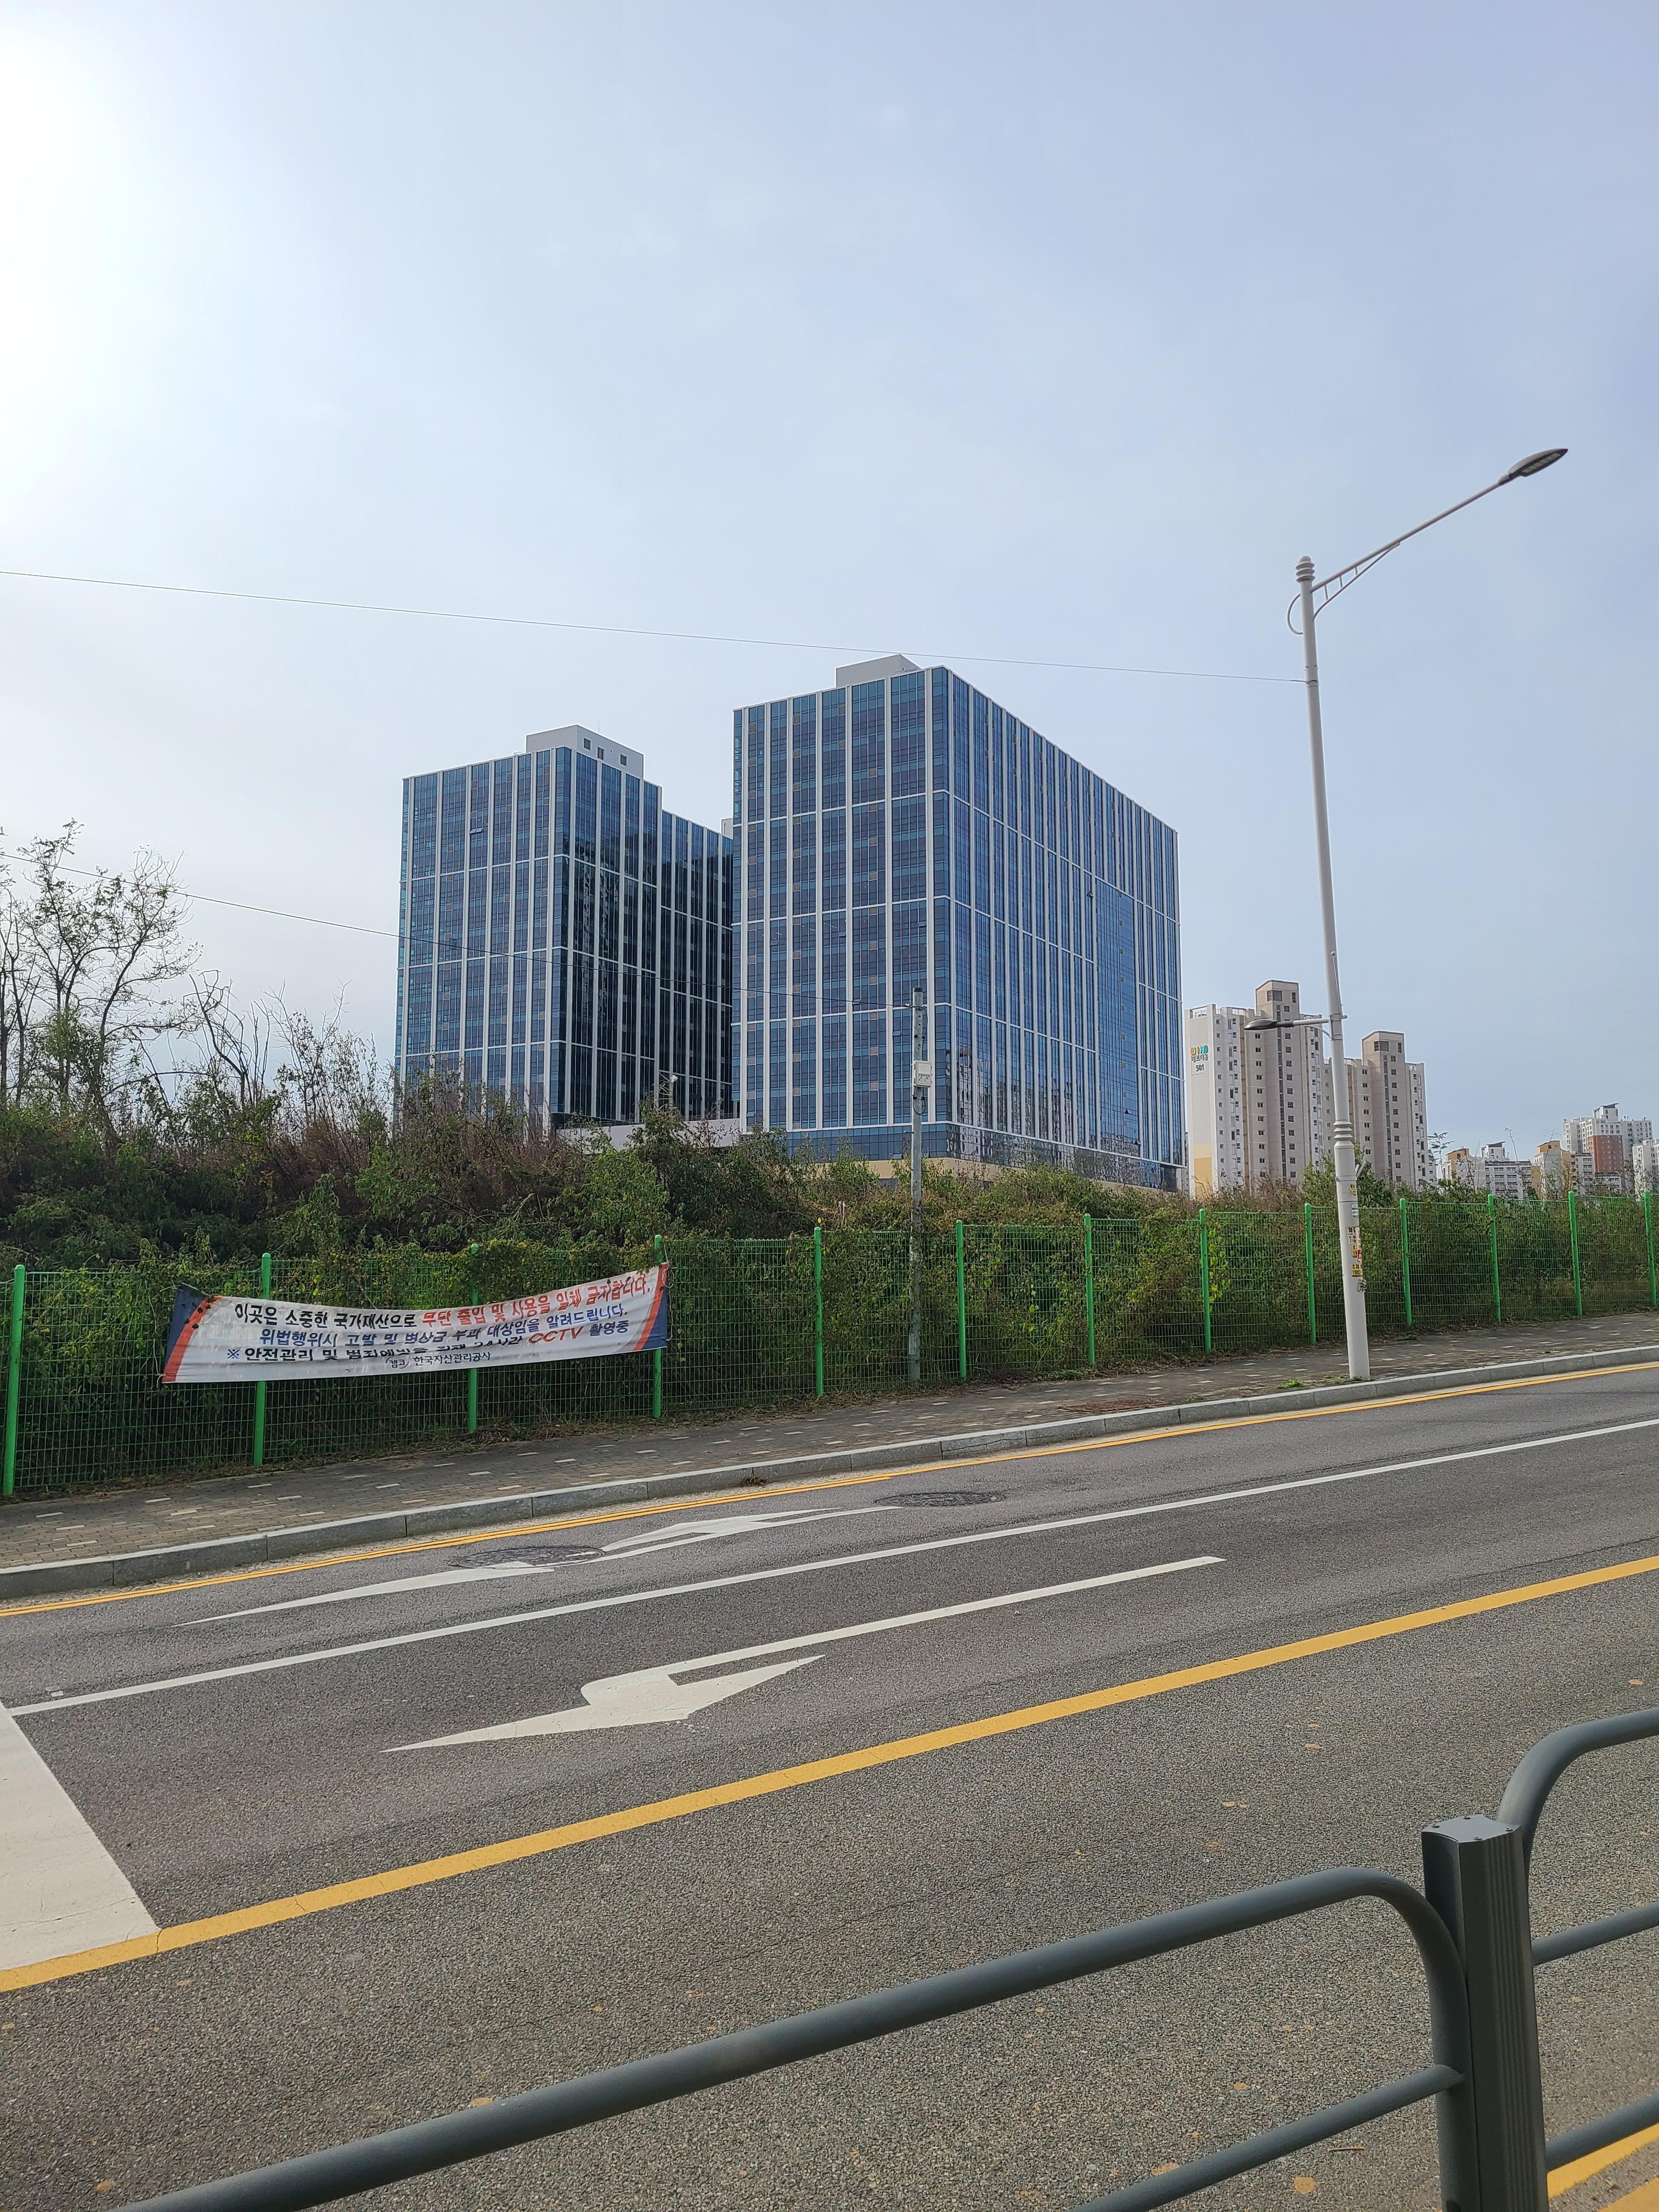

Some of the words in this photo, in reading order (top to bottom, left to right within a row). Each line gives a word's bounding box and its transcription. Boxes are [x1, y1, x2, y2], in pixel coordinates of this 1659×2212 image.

[235, 1303, 278, 1325] 이곳은
[285, 1310, 328, 1328] 소중한
[334, 1313, 417, 1329] 국가재산으로
[422, 1310, 452, 1327] 무단
[457, 1306, 486, 1326] 출입
[492, 1303, 506, 1323] 및
[512, 1295, 551, 1318] 사용을
[556, 1288, 582, 1311] 일체
[586, 1273, 651, 1306] 금지합니다.
[244, 1347, 313, 1361] 안전관리
[322, 1348, 338, 1361] 및
[528, 1326, 584, 1344] CCTV
[589, 1319, 630, 1337] 촬영중
[259, 1329, 338, 1347] 위법행위시
[345, 1333, 377, 1346] 고발
[404, 1331, 448, 1344] 변상금
[452, 1327, 483, 1341] 부과
[487, 1318, 540, 1338] 대상임을
[546, 1303, 628, 1329] 알려드립니다.
[413, 1351, 492, 1367] 한국자산관리공사
